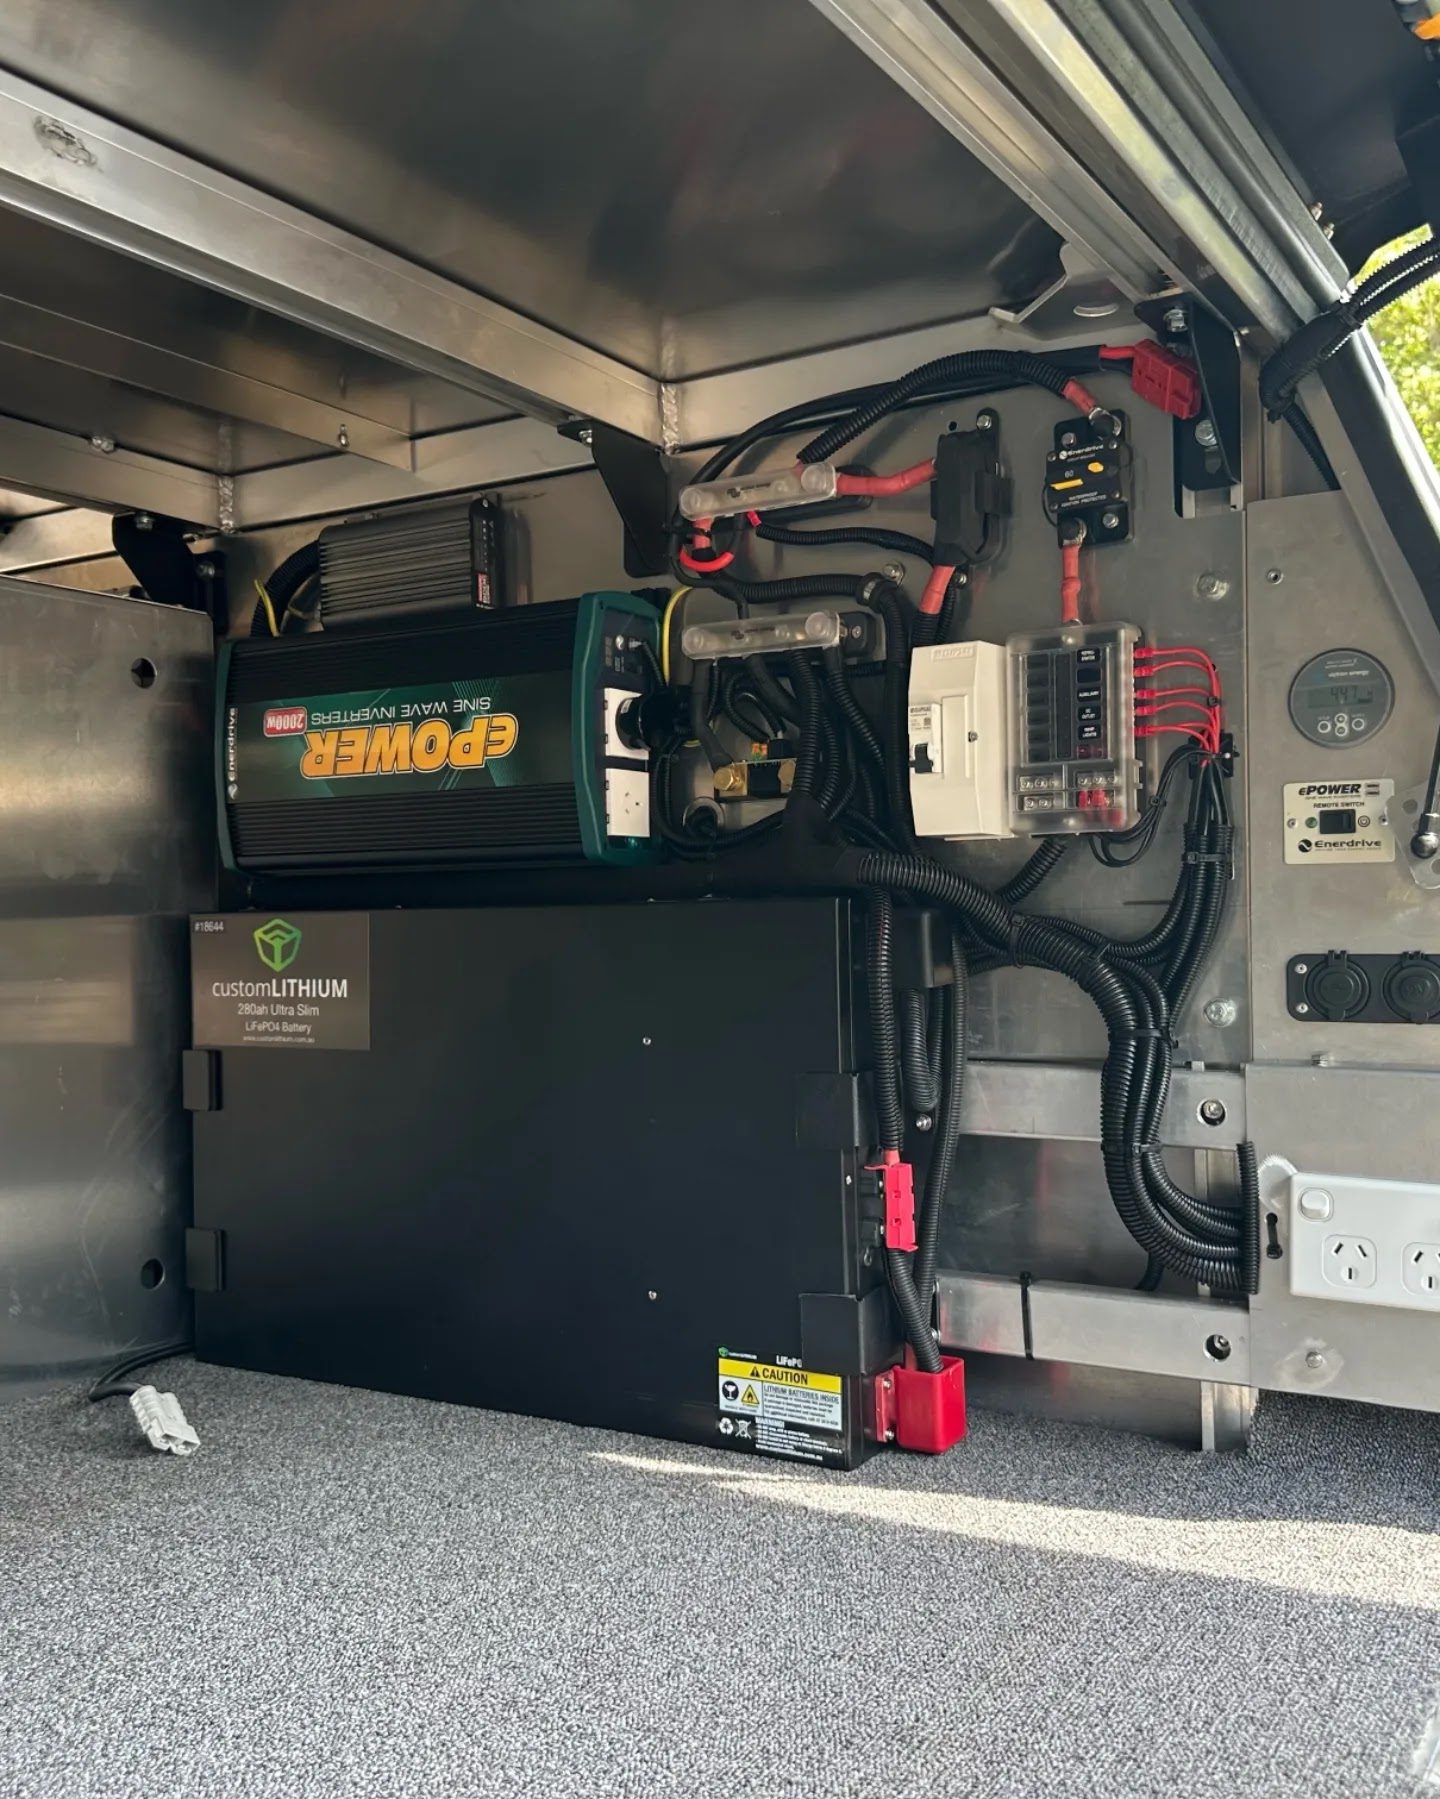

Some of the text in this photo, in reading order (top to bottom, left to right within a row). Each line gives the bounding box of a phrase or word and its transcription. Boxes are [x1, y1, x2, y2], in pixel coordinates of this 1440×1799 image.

[311, 696, 492, 726] SINE WAVE INVERTERS
[300, 713, 520, 780] ePOWER
[1314, 839, 1382, 849] Enerdrive
[195, 921, 225, 932] #18644
[212, 978, 348, 998] customLITHIUM
[237, 1003, 320, 1017] 280ah Ultra Slim
[245, 1021, 312, 1036] LiFePO4 Battery
[762, 1367, 809, 1385] CAUTION
[763, 1384, 788, 1394] LITHIUM
